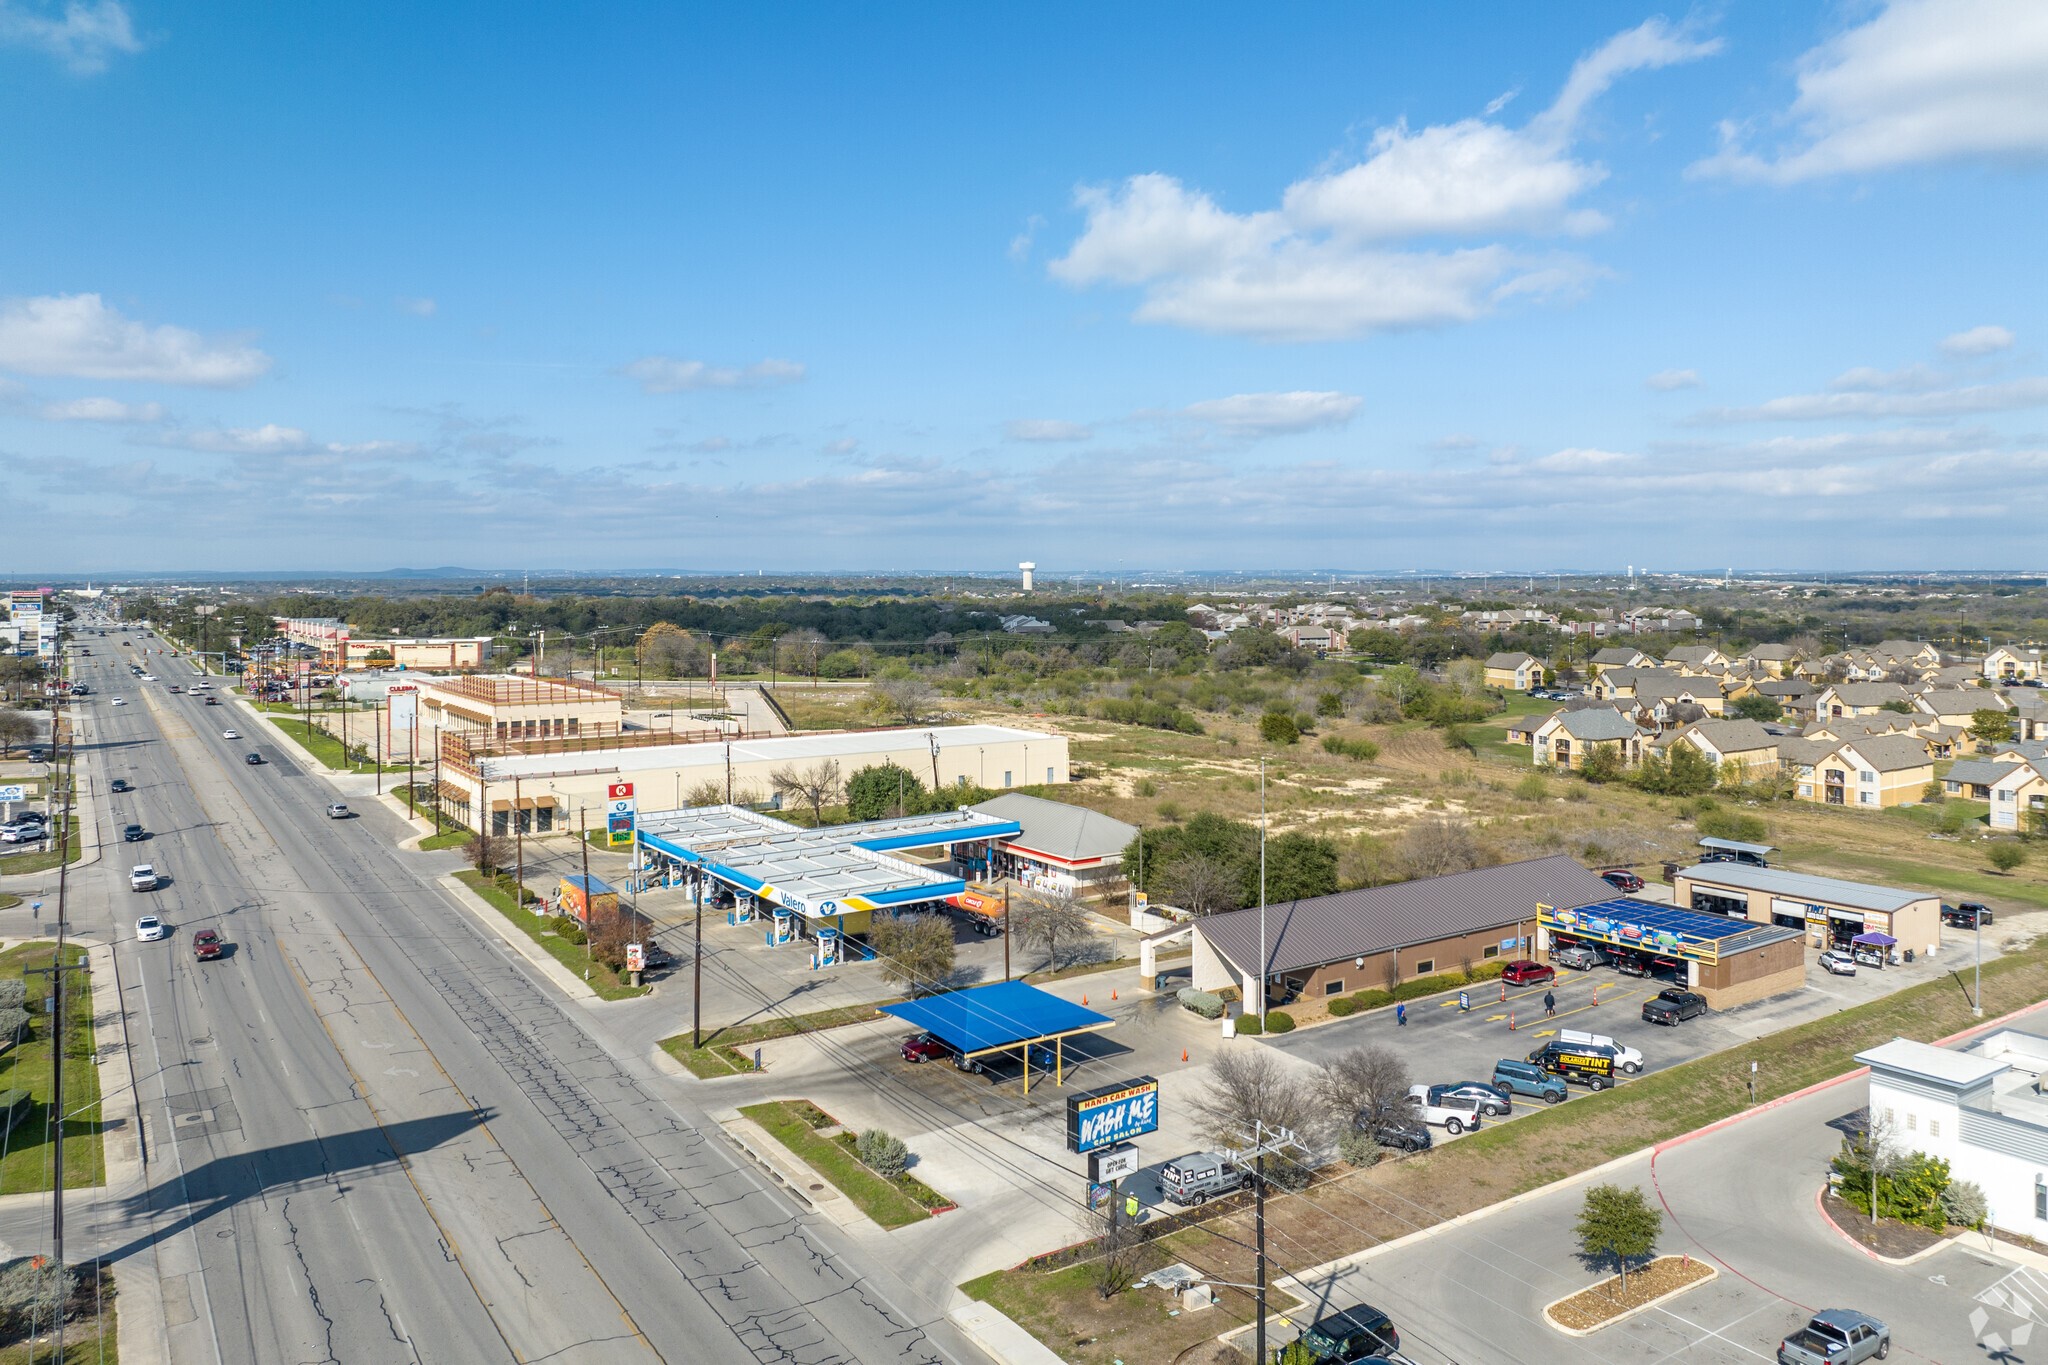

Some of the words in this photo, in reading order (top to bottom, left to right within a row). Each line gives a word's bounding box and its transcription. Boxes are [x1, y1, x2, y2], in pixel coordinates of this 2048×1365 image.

[781, 891, 806, 913] Valero
[1805, 903, 1826, 914] TINT
[1584, 1056, 1610, 1068] TINT
[1084, 1097, 1108, 1109] HAND
[1110, 1092, 1126, 1101] CAR
[1128, 1085, 1151, 1096] WASH
[1081, 1103, 1126, 1144] WASH
[1127, 1092, 1155, 1125] ME
[1093, 1135, 1112, 1146] CAR
[1113, 1127, 1142, 1140] SALON
[1107, 1160, 1118, 1168] OPEN
[1163, 1168, 1181, 1184] TINT
